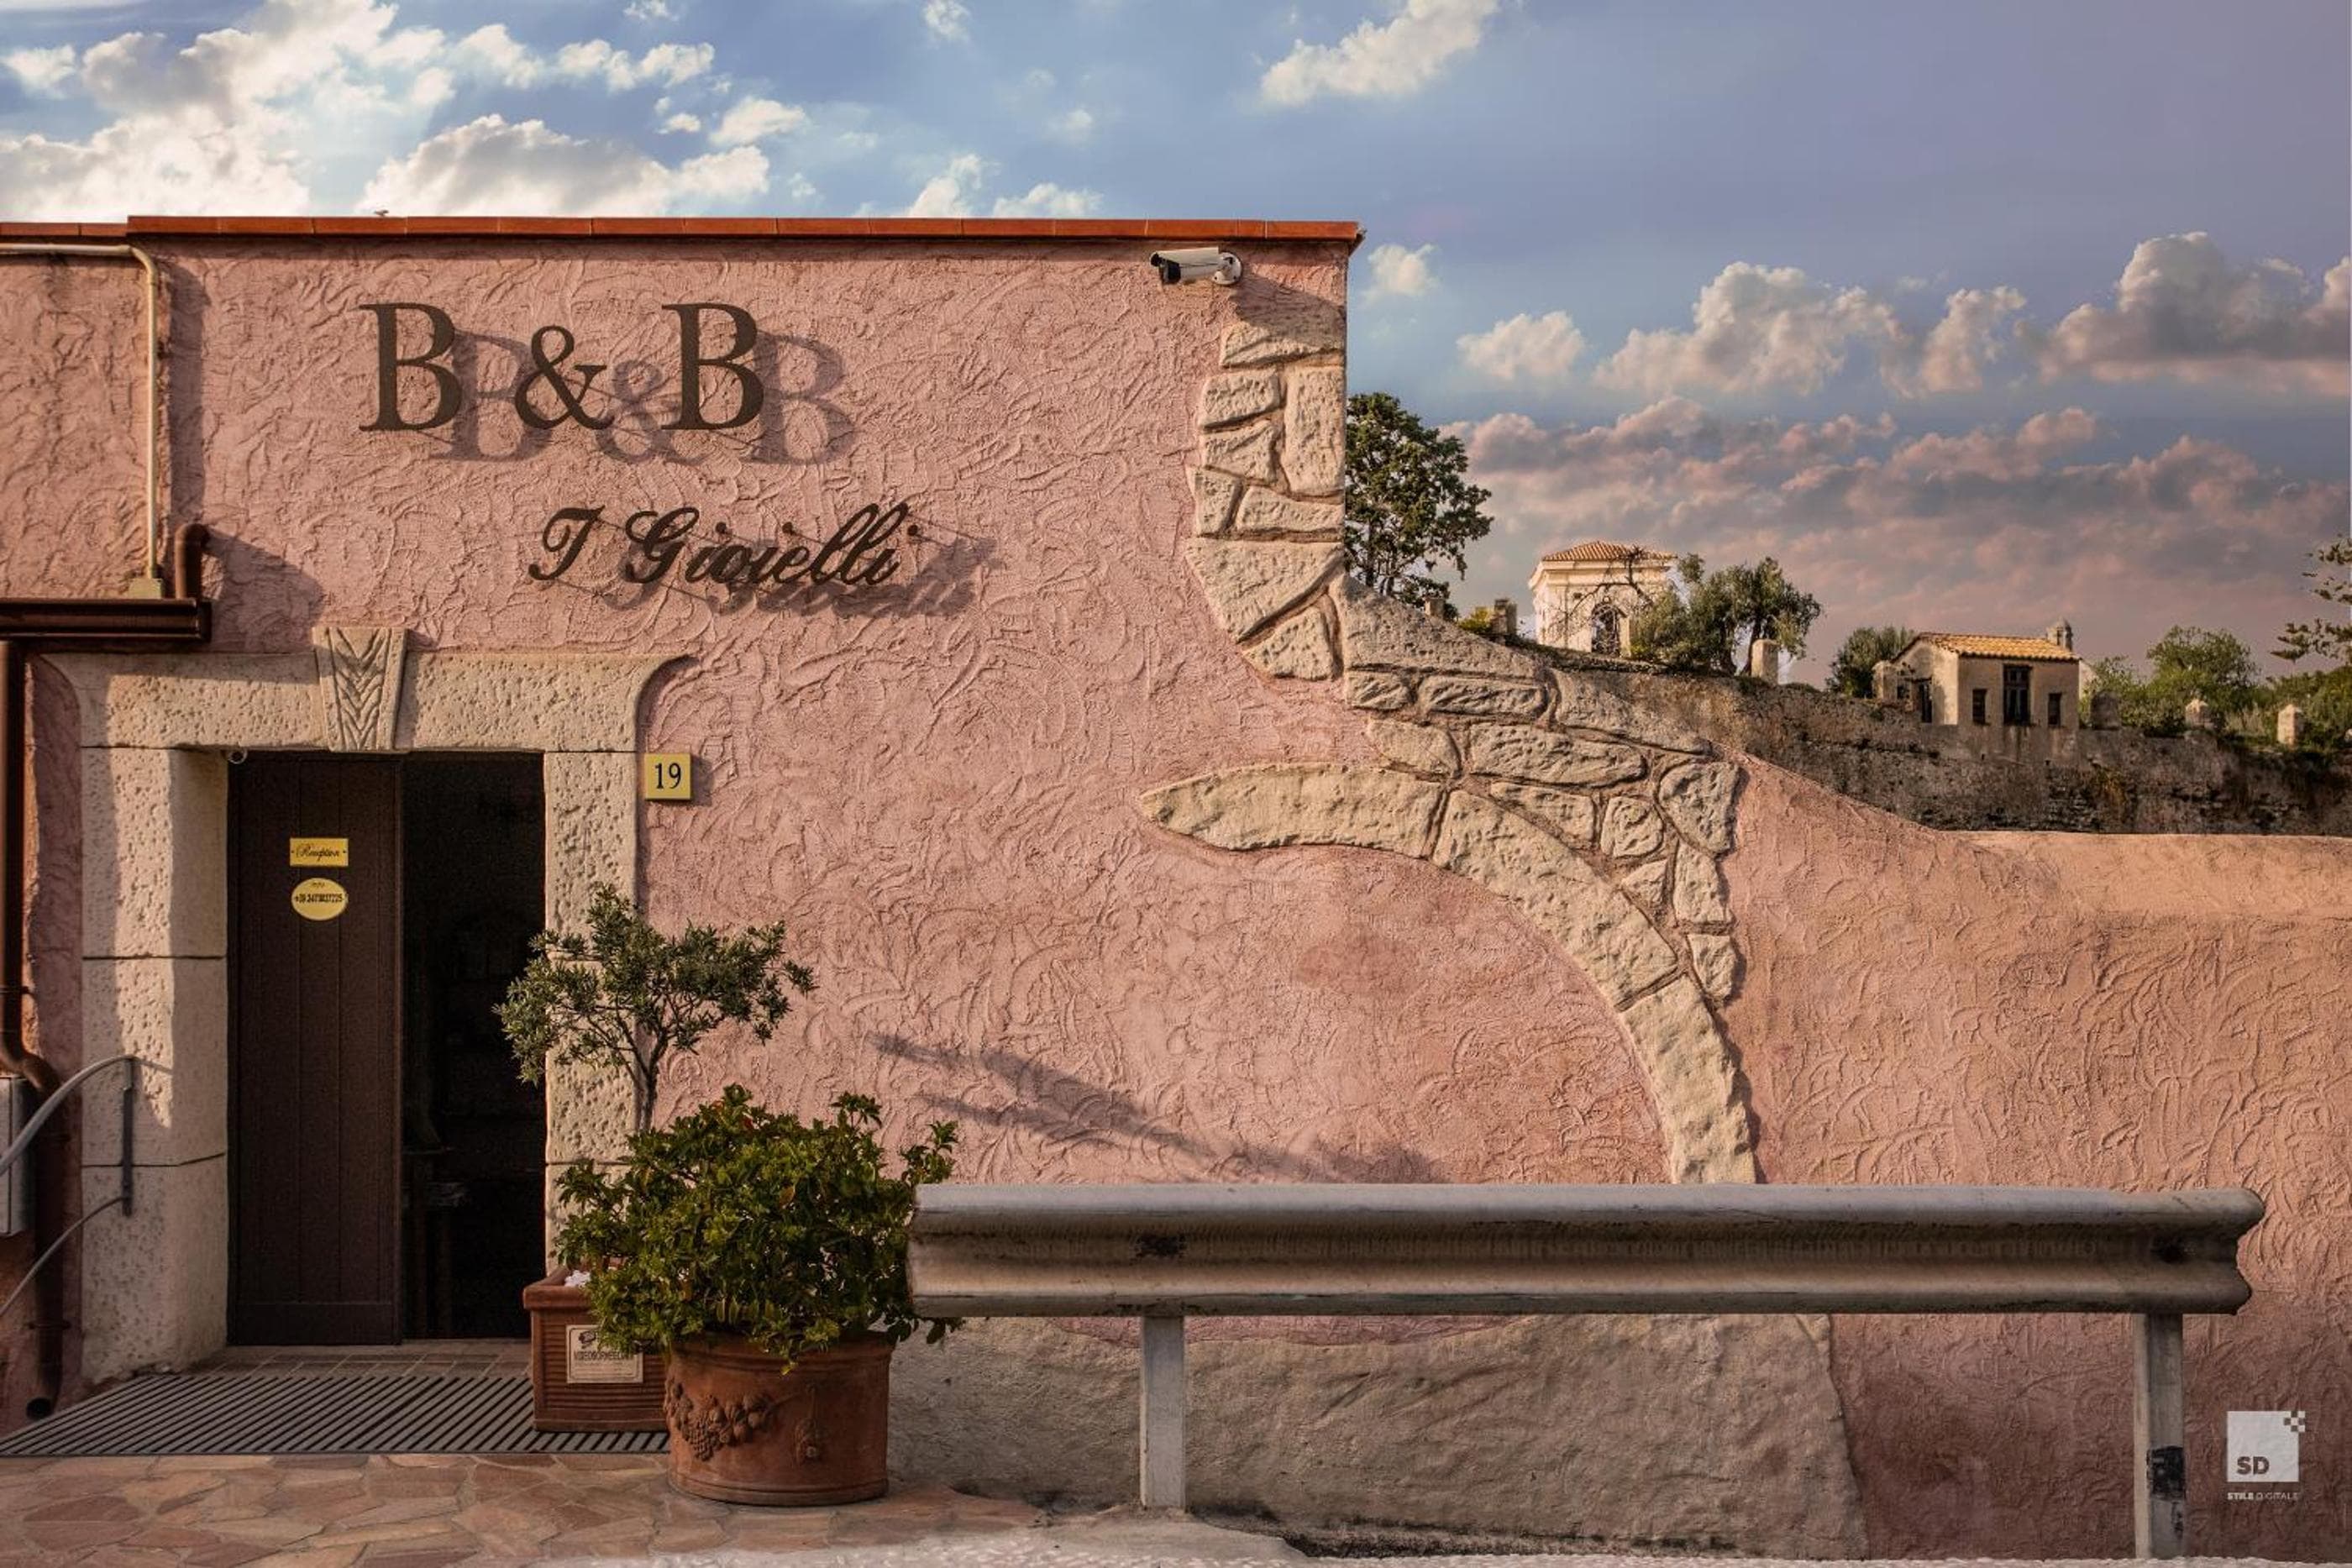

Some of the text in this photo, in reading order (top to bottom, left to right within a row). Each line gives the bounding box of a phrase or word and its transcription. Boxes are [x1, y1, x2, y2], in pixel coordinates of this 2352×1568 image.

[624, 503, 919, 586] Gioielli
[654, 762, 682, 789] 19
[296, 842, 340, 863] Reception
